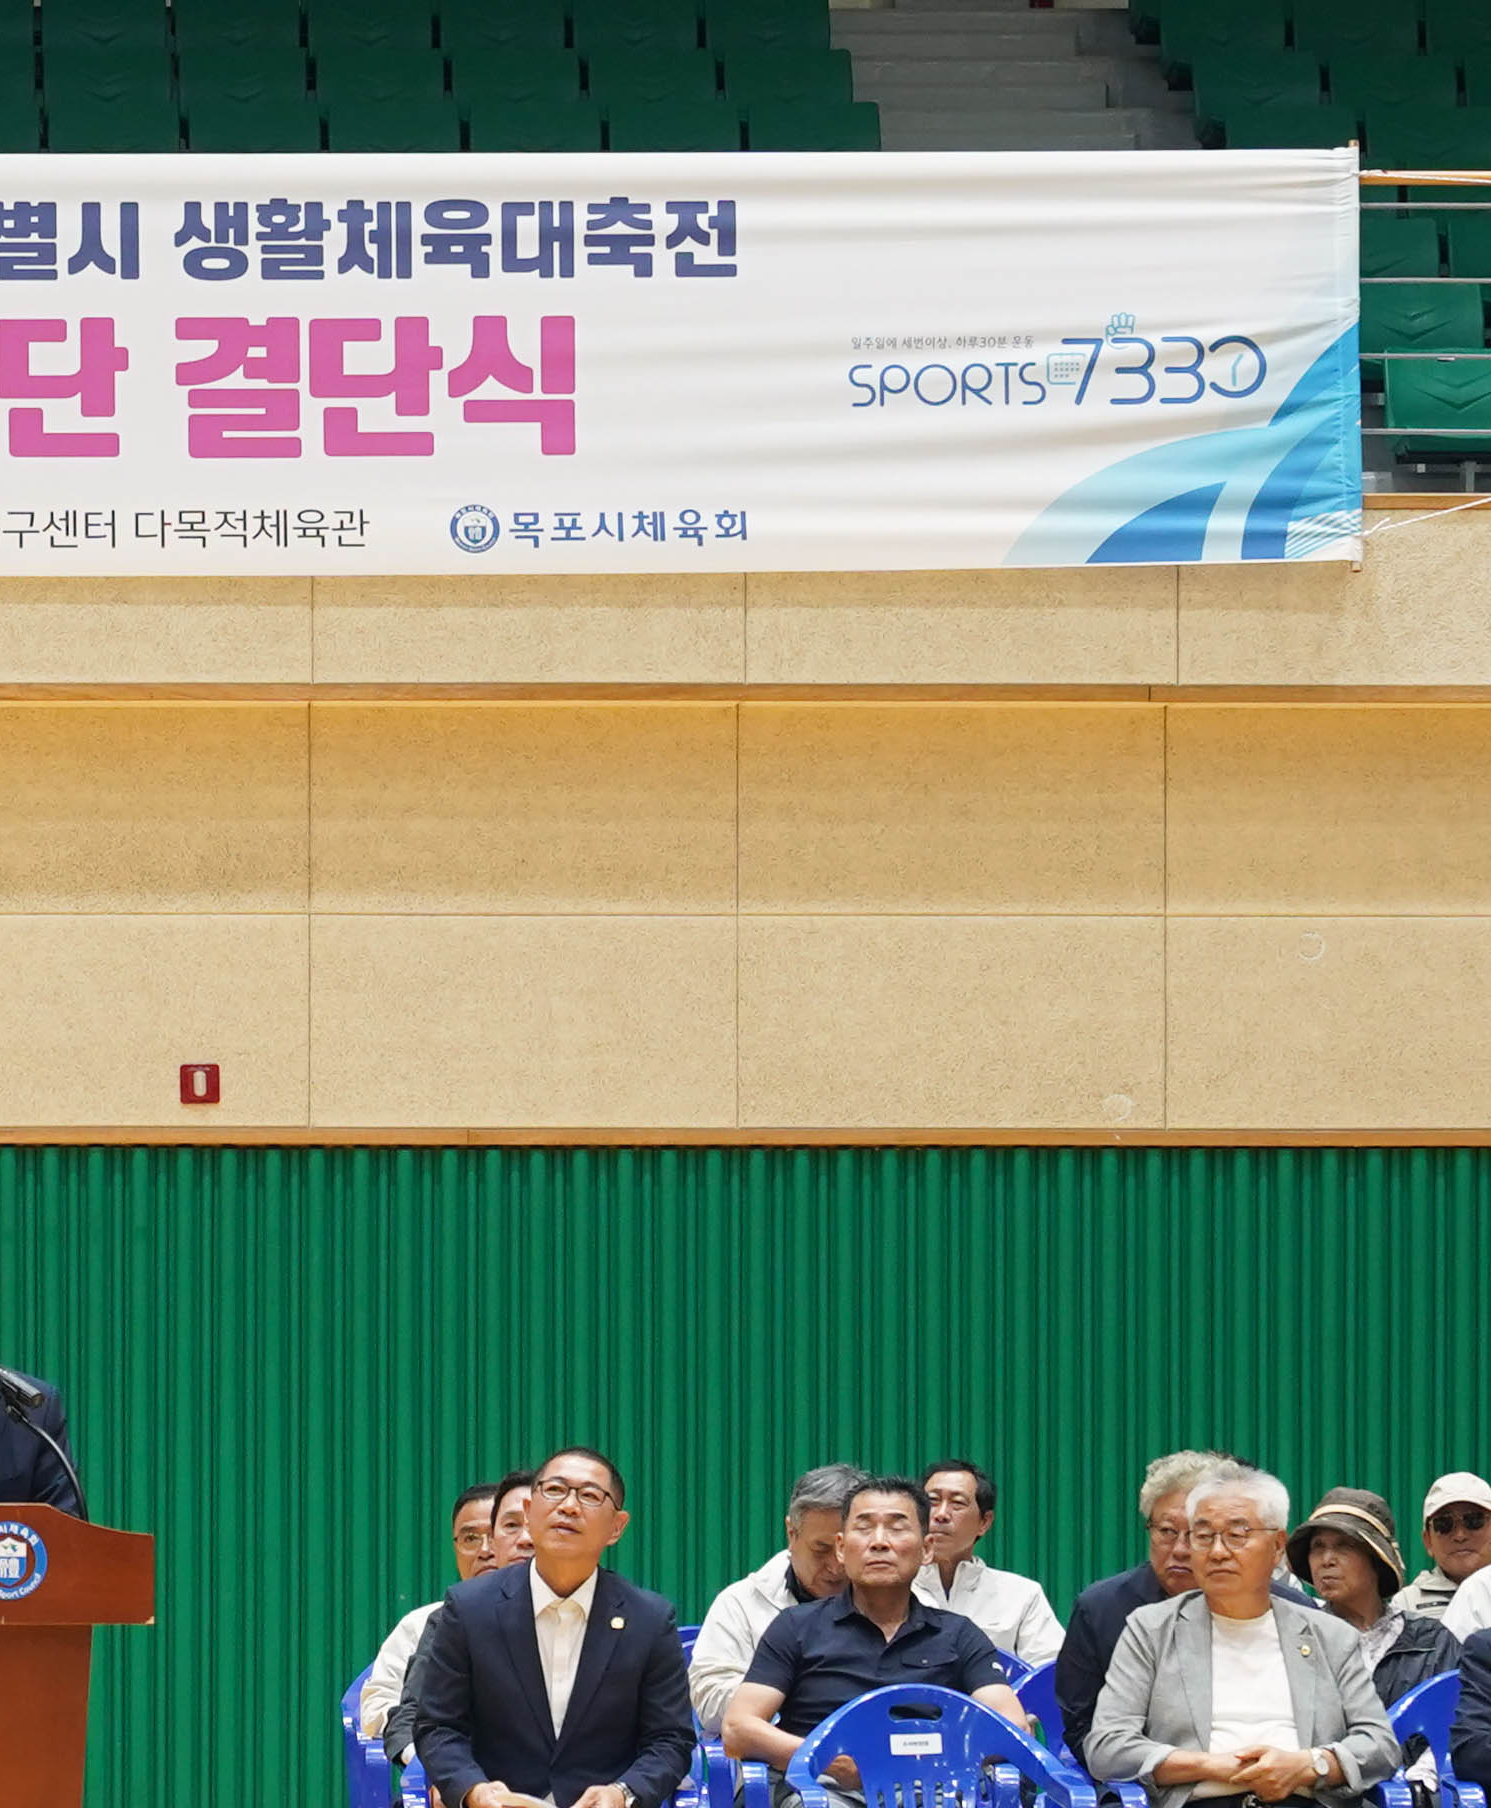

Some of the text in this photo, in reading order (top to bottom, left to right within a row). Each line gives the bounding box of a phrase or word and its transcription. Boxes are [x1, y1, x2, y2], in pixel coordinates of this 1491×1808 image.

[173, 196, 738, 282] 생활체육대축전
[851, 336, 898, 350] 일주일에
[955, 335, 1008, 349] 하루30분
[1011, 335, 1035, 349] 운동
[174, 314, 577, 459] 결단식
[848, 335, 1268, 408] SPORTS 7330
[134, 508, 371, 550] 다목적체육관
[508, 508, 748, 549] 목포시체육회
